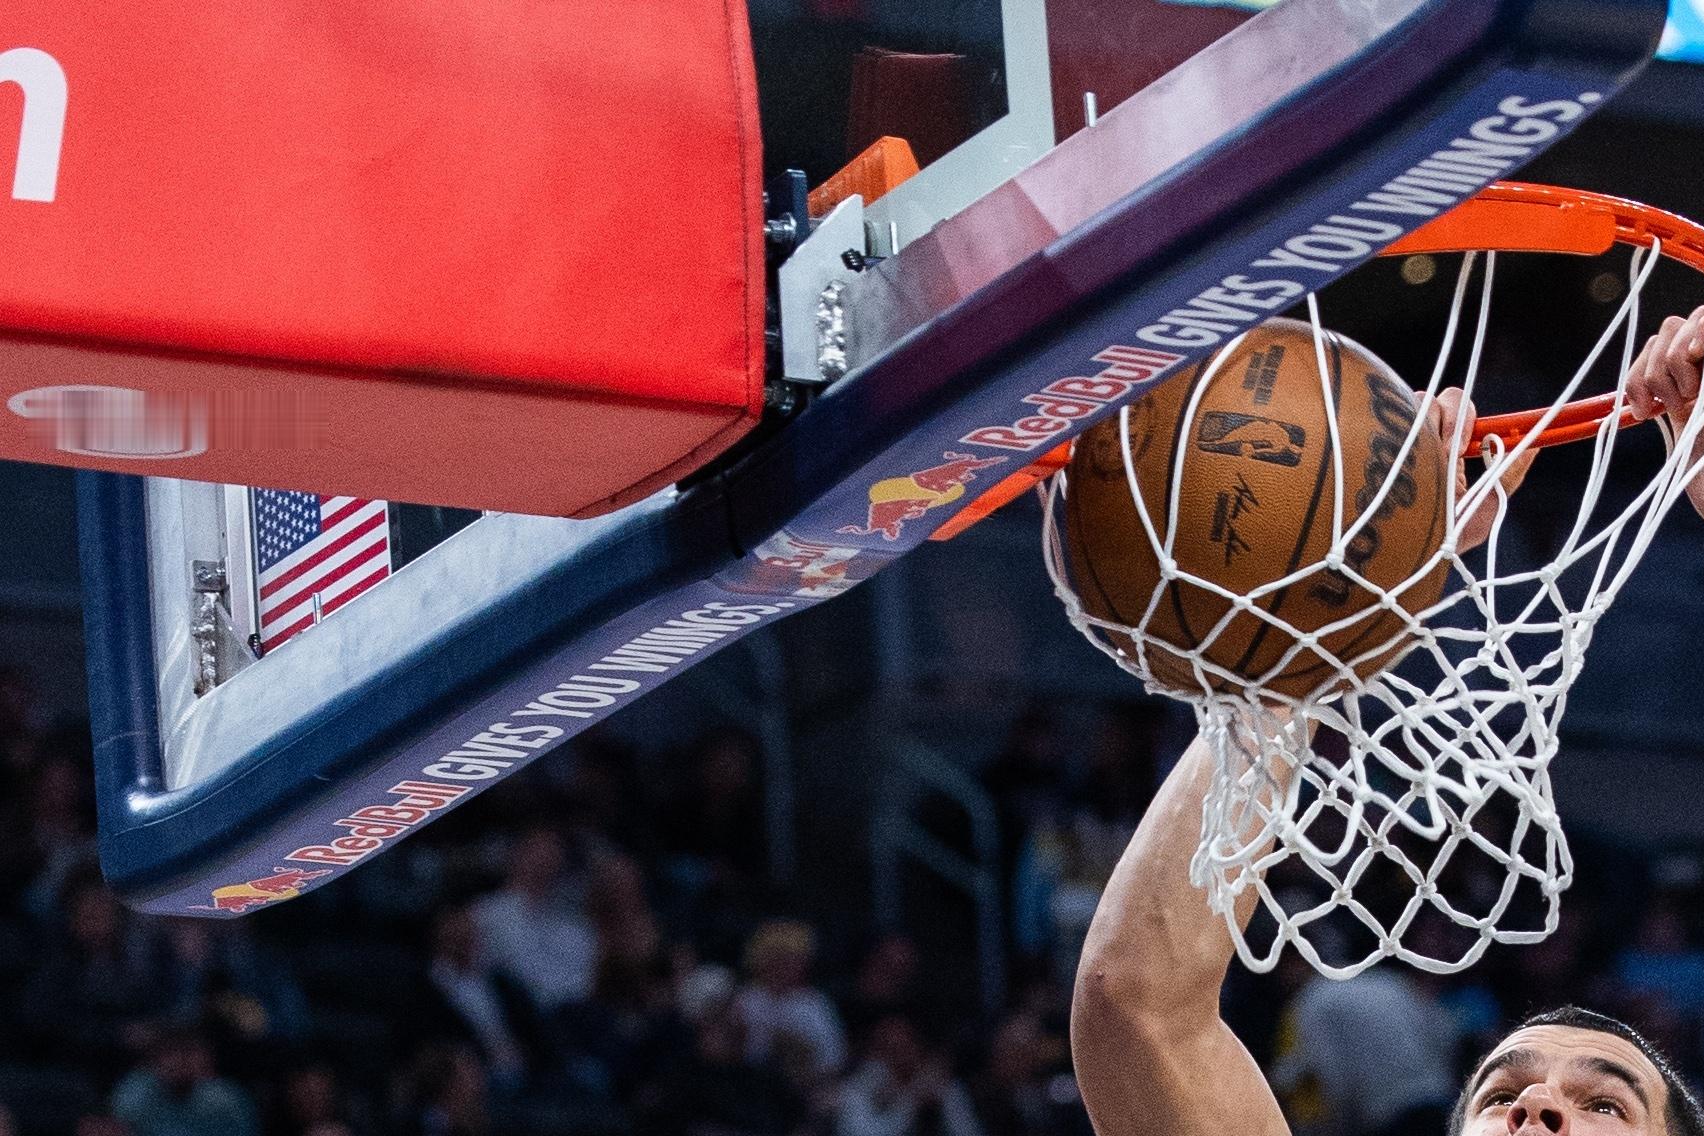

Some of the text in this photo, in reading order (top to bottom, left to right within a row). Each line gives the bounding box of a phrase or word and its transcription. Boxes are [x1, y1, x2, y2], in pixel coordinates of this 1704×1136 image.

[1135, 274, 1305, 348] GIVES
[1252, 215, 1403, 273] YOU
[422, 721, 566, 781] GIVES
[510, 674, 642, 719] YOU
